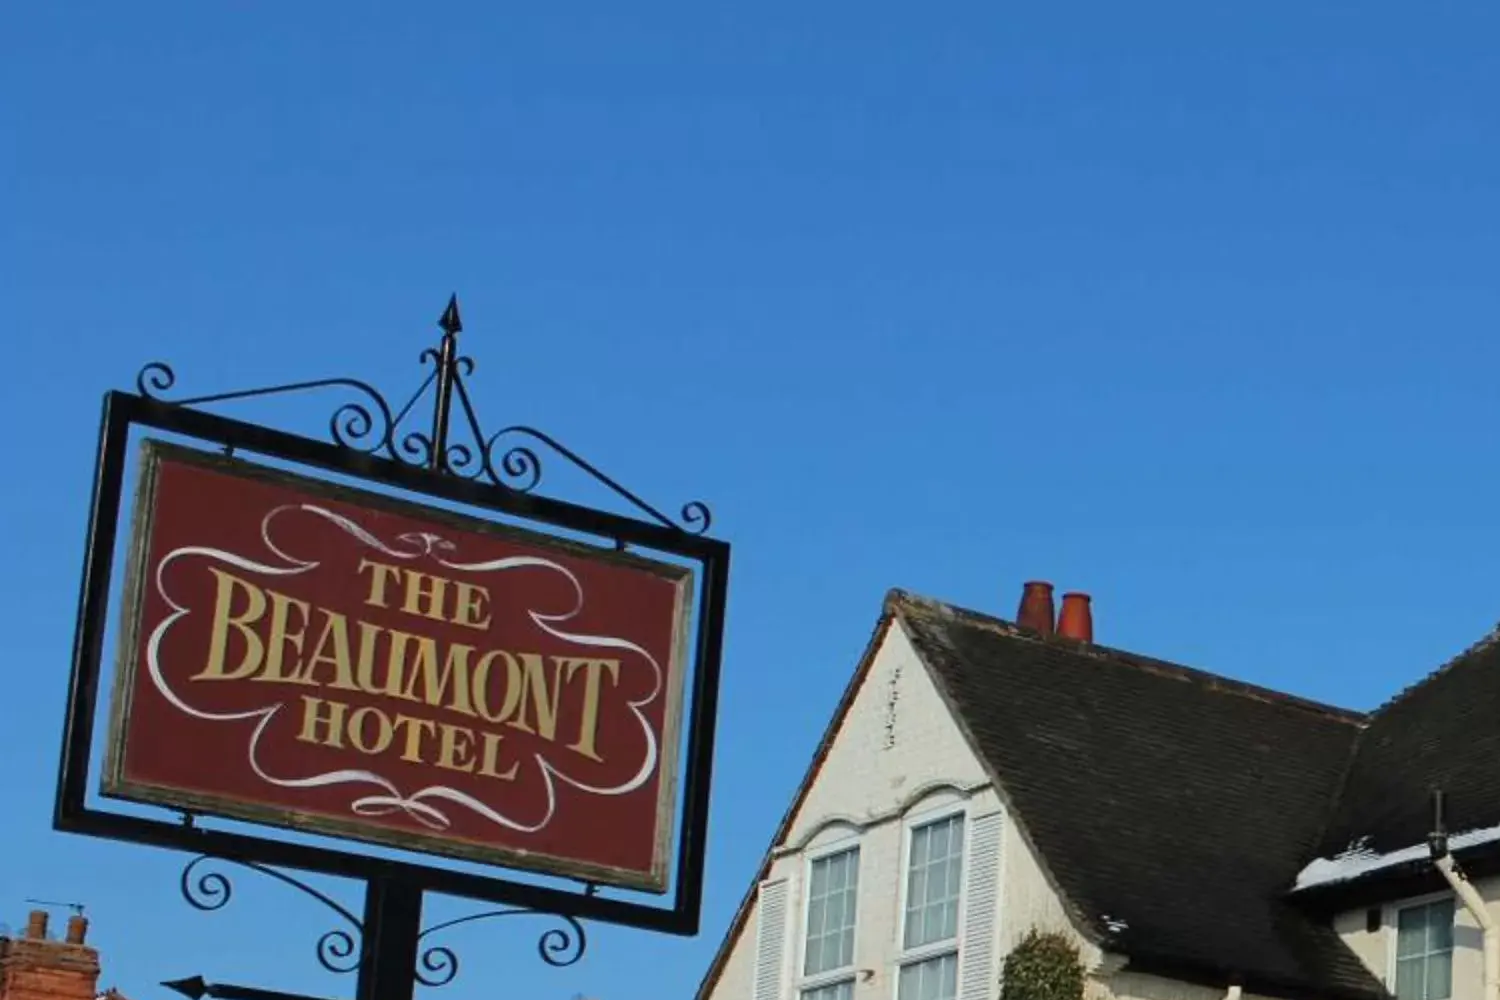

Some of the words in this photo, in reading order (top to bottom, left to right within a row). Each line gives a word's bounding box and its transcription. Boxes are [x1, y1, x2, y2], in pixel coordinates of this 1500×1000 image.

[359, 559, 491, 630] THE
[190, 567, 620, 762] BEAUMONT
[296, 696, 519, 780] HOTEL
